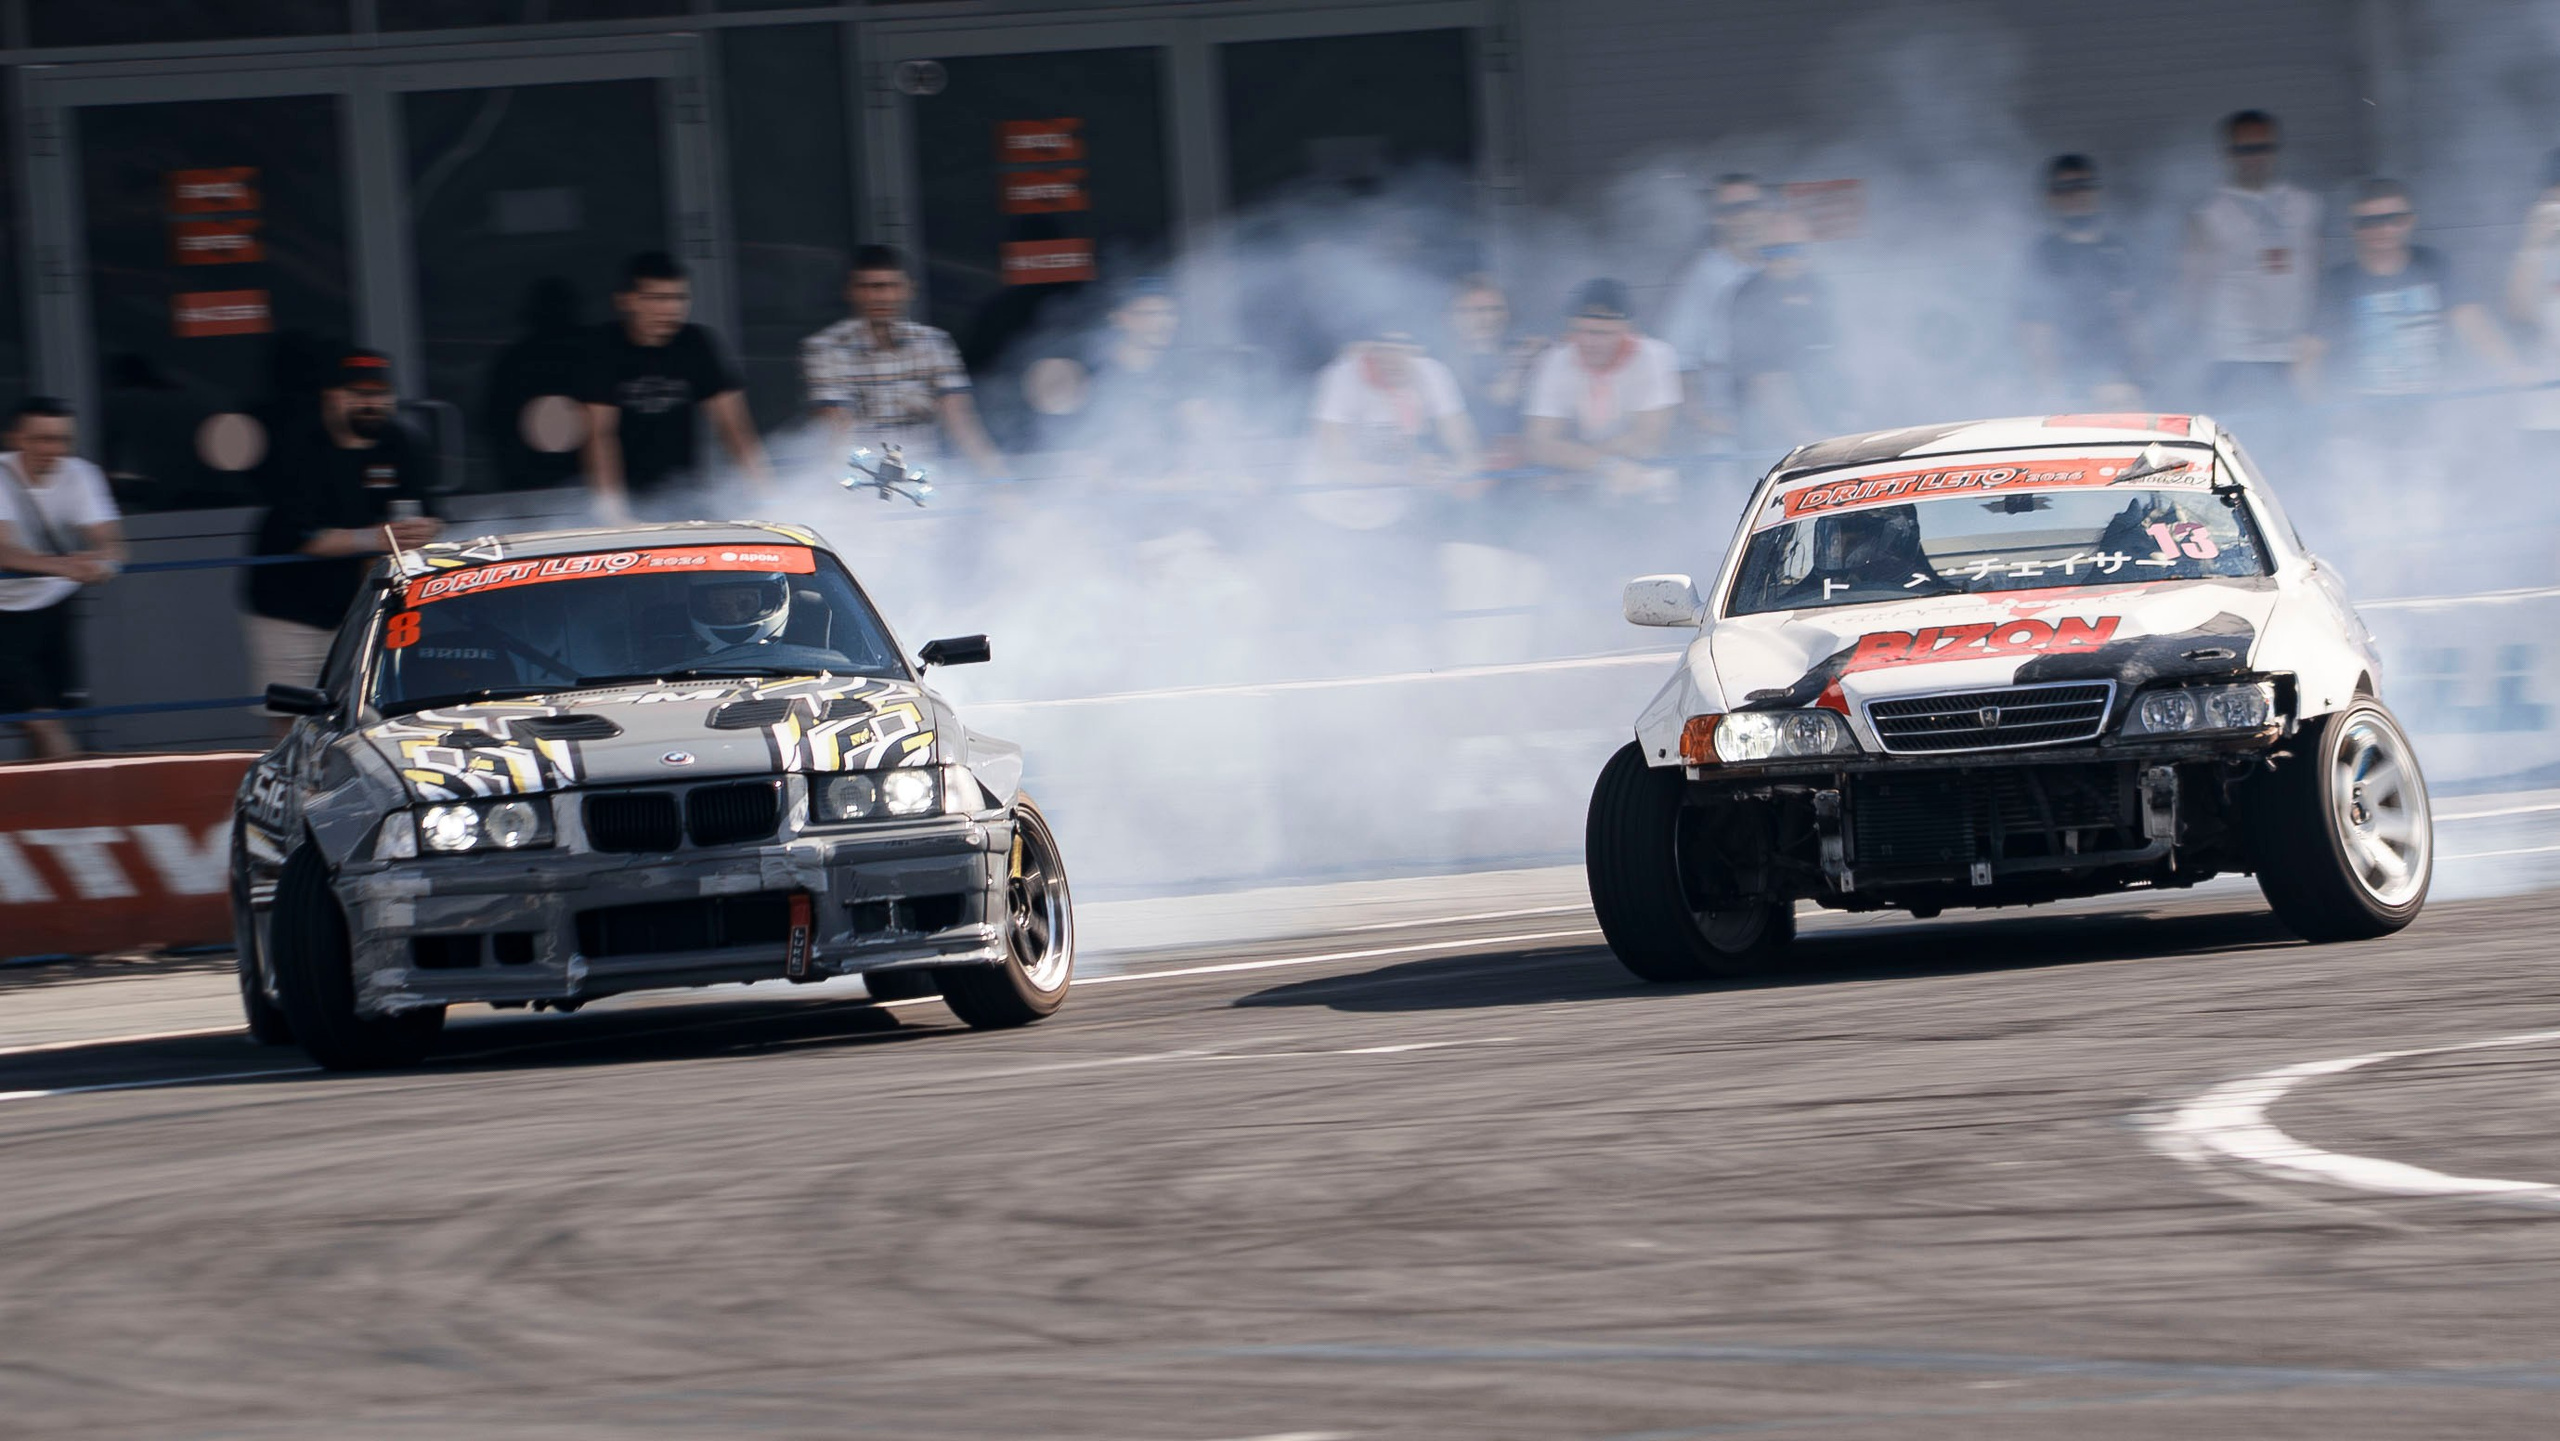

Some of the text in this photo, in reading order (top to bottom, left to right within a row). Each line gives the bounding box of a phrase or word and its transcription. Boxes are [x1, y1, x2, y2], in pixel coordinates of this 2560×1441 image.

[1799, 475, 1917, 509] DRIFT
[2024, 470, 2085, 483] 2026
[2146, 521, 2219, 561] 13
[420, 562, 540, 599] DRIFT
[649, 555, 707, 567] 2026
[386, 611, 422, 650] 8
[1848, 615, 2122, 665] BIZON
[418, 647, 497, 661] BRIDE
